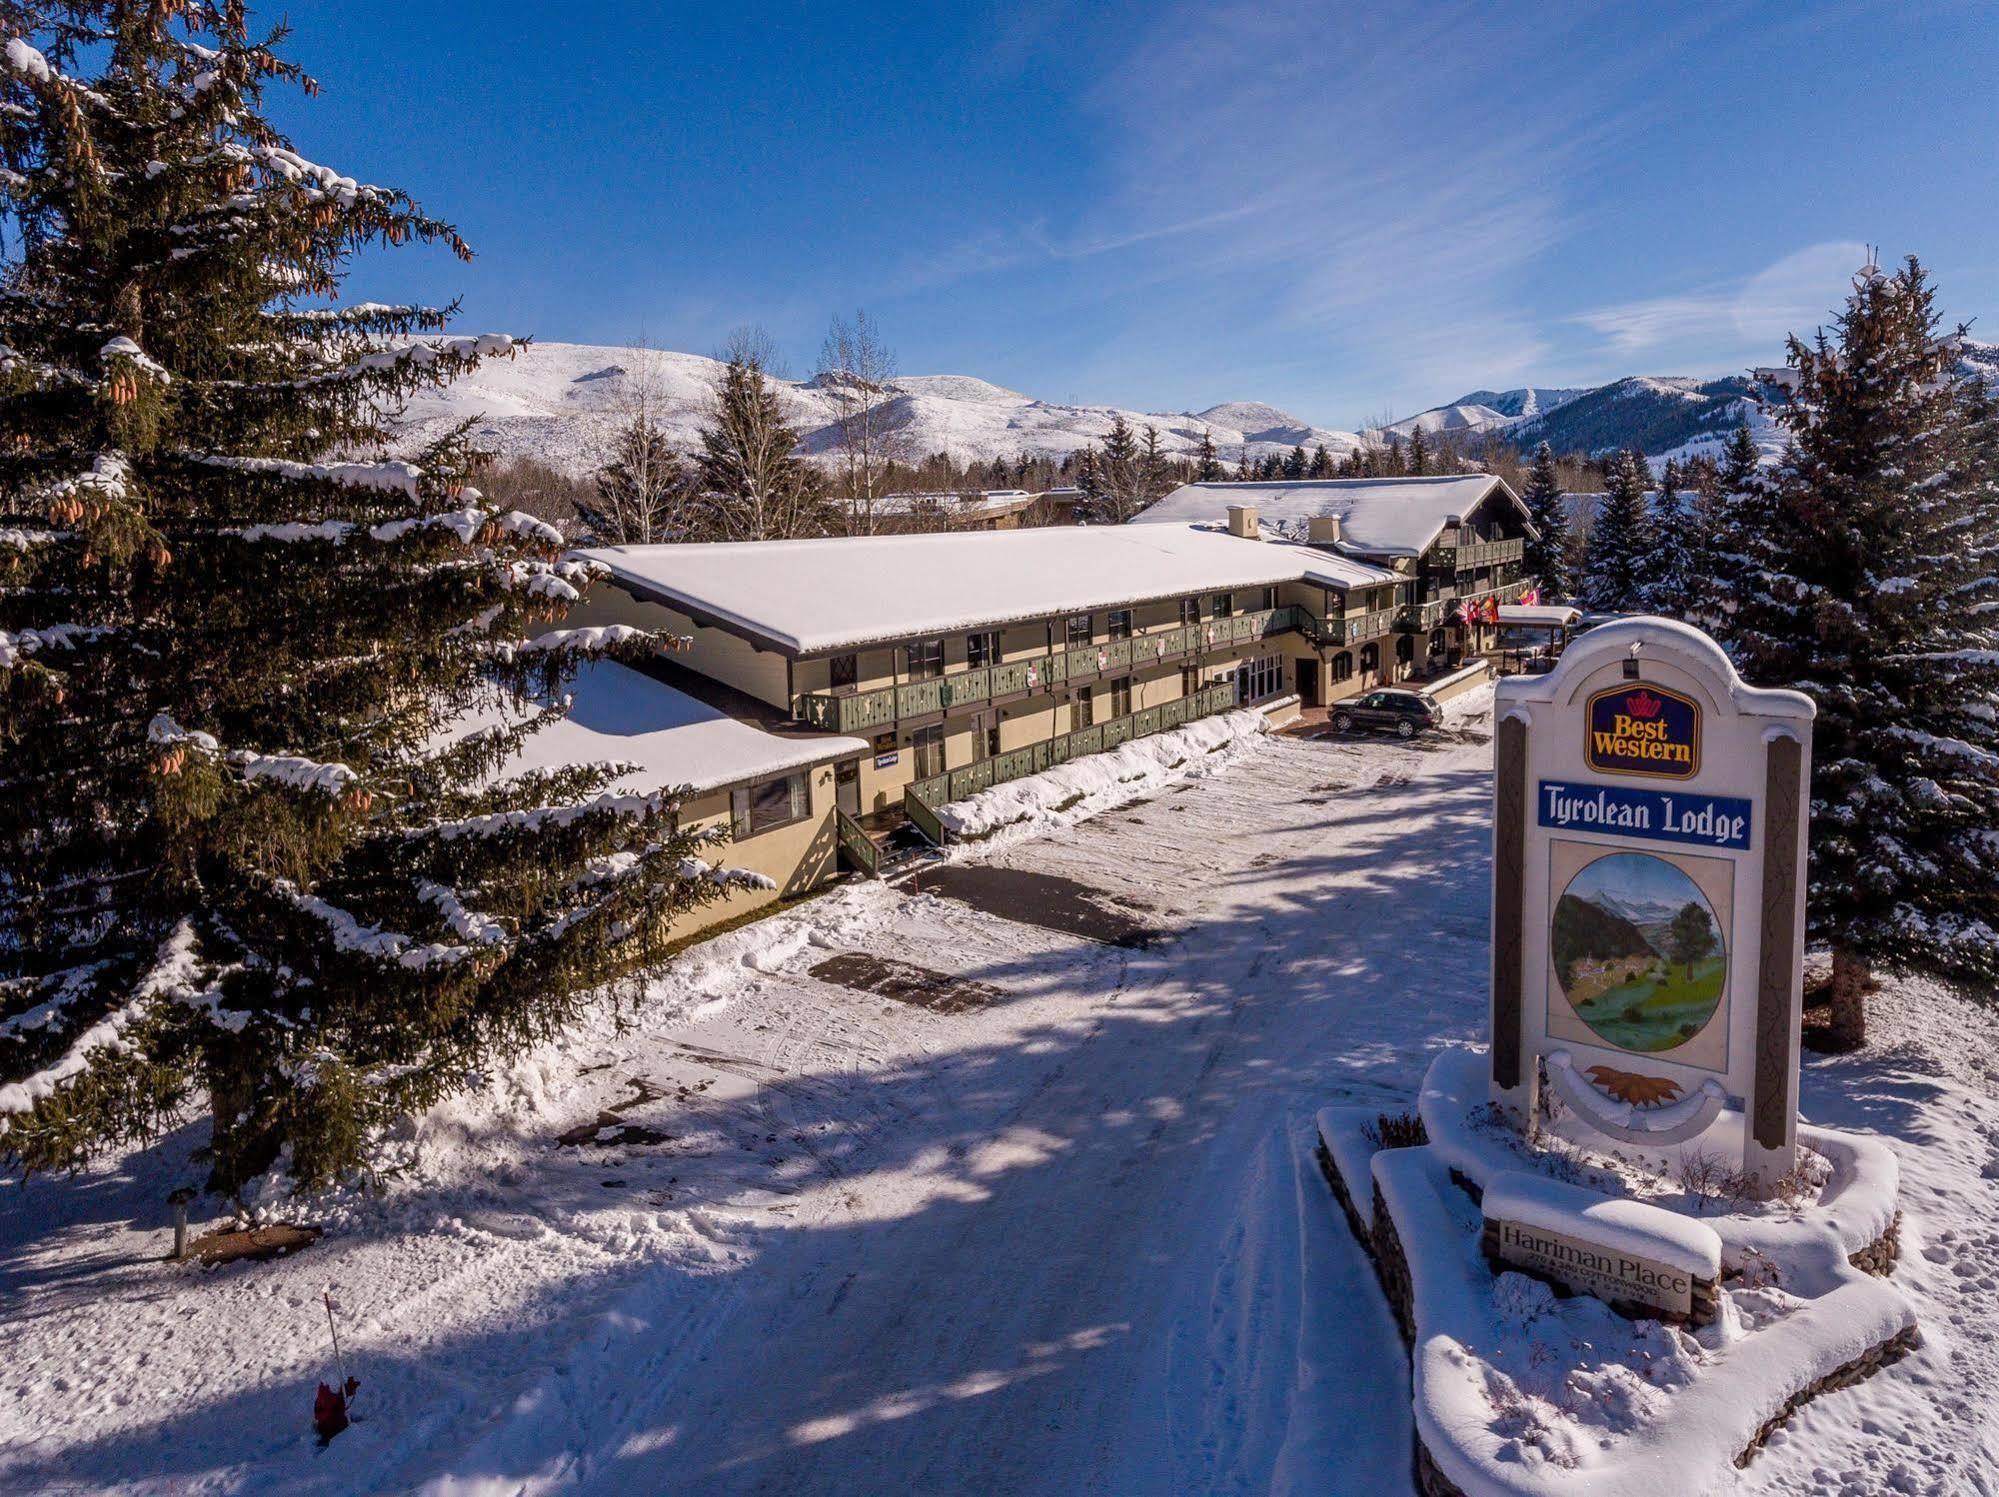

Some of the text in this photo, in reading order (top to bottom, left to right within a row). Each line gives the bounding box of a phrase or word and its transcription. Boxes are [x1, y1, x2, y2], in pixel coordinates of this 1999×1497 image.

[1593, 731, 1691, 763] Western
[1614, 714, 1668, 741] Best
[1544, 785, 1745, 843] Tyrolean Lodge
[1504, 1226, 1688, 1295] Harriman Place
